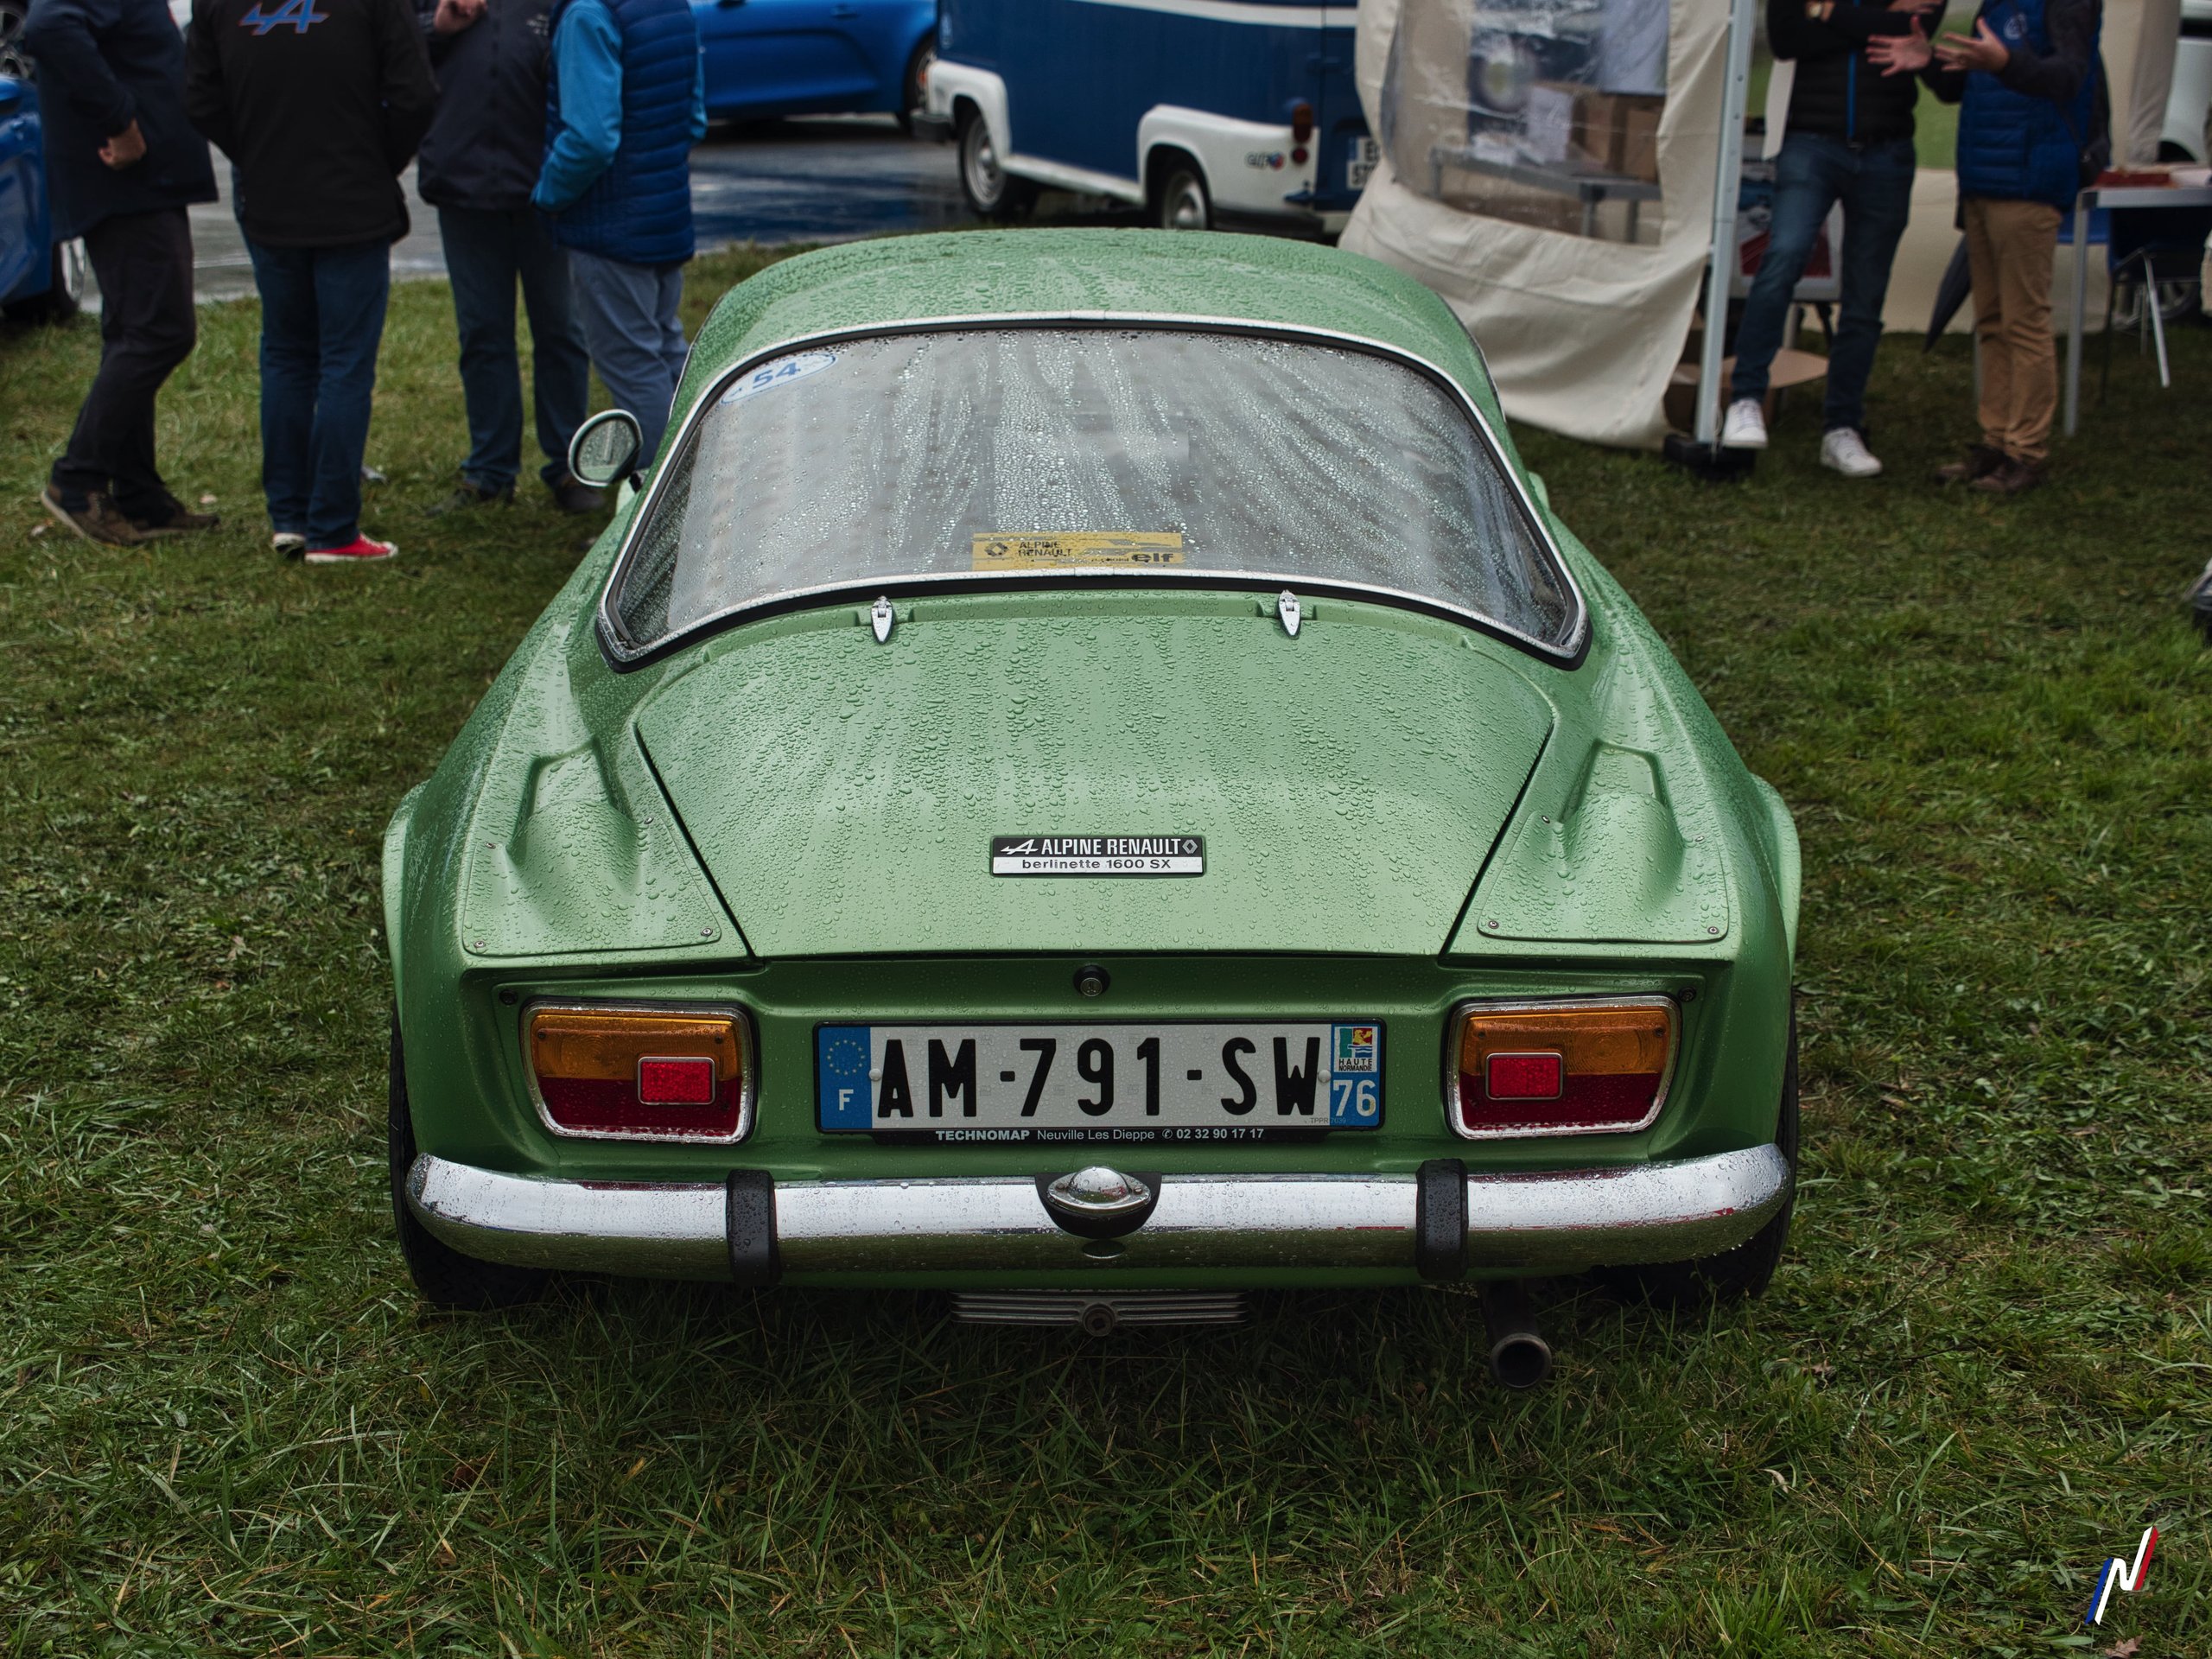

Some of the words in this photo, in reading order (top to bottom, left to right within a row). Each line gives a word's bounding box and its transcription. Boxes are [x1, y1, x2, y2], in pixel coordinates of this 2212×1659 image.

[753, 361, 798, 389] 54
[1019, 548, 1072, 557] RENAULT
[1020, 541, 1061, 550] ALPINE
[1131, 553, 1174, 563] elf
[1041, 838, 1102, 855] ALPINE
[1107, 838, 1181, 855] RENAULT
[1022, 859, 1101, 869] berlinette
[1106, 859, 1145, 869] 1600
[1149, 859, 1172, 869] SX
[877, 1037, 1321, 1118] AM-791-SW
[838, 1089, 855, 1111] F
[1333, 1079, 1376, 1117] 76
[935, 1129, 1031, 1141] TECHNOMAP
[1037, 1129, 1085, 1141] Neuville
[1088, 1129, 1109, 1140] Les
[1113, 1128, 1155, 1141] Dieppe
[1176, 1128, 1191, 1140] 02
[1194, 1128, 1210, 1140] 32
[1212, 1128, 1228, 1140] 90
[1231, 1128, 1246, 1140] 17
[1249, 1128, 1264, 1140] 17
